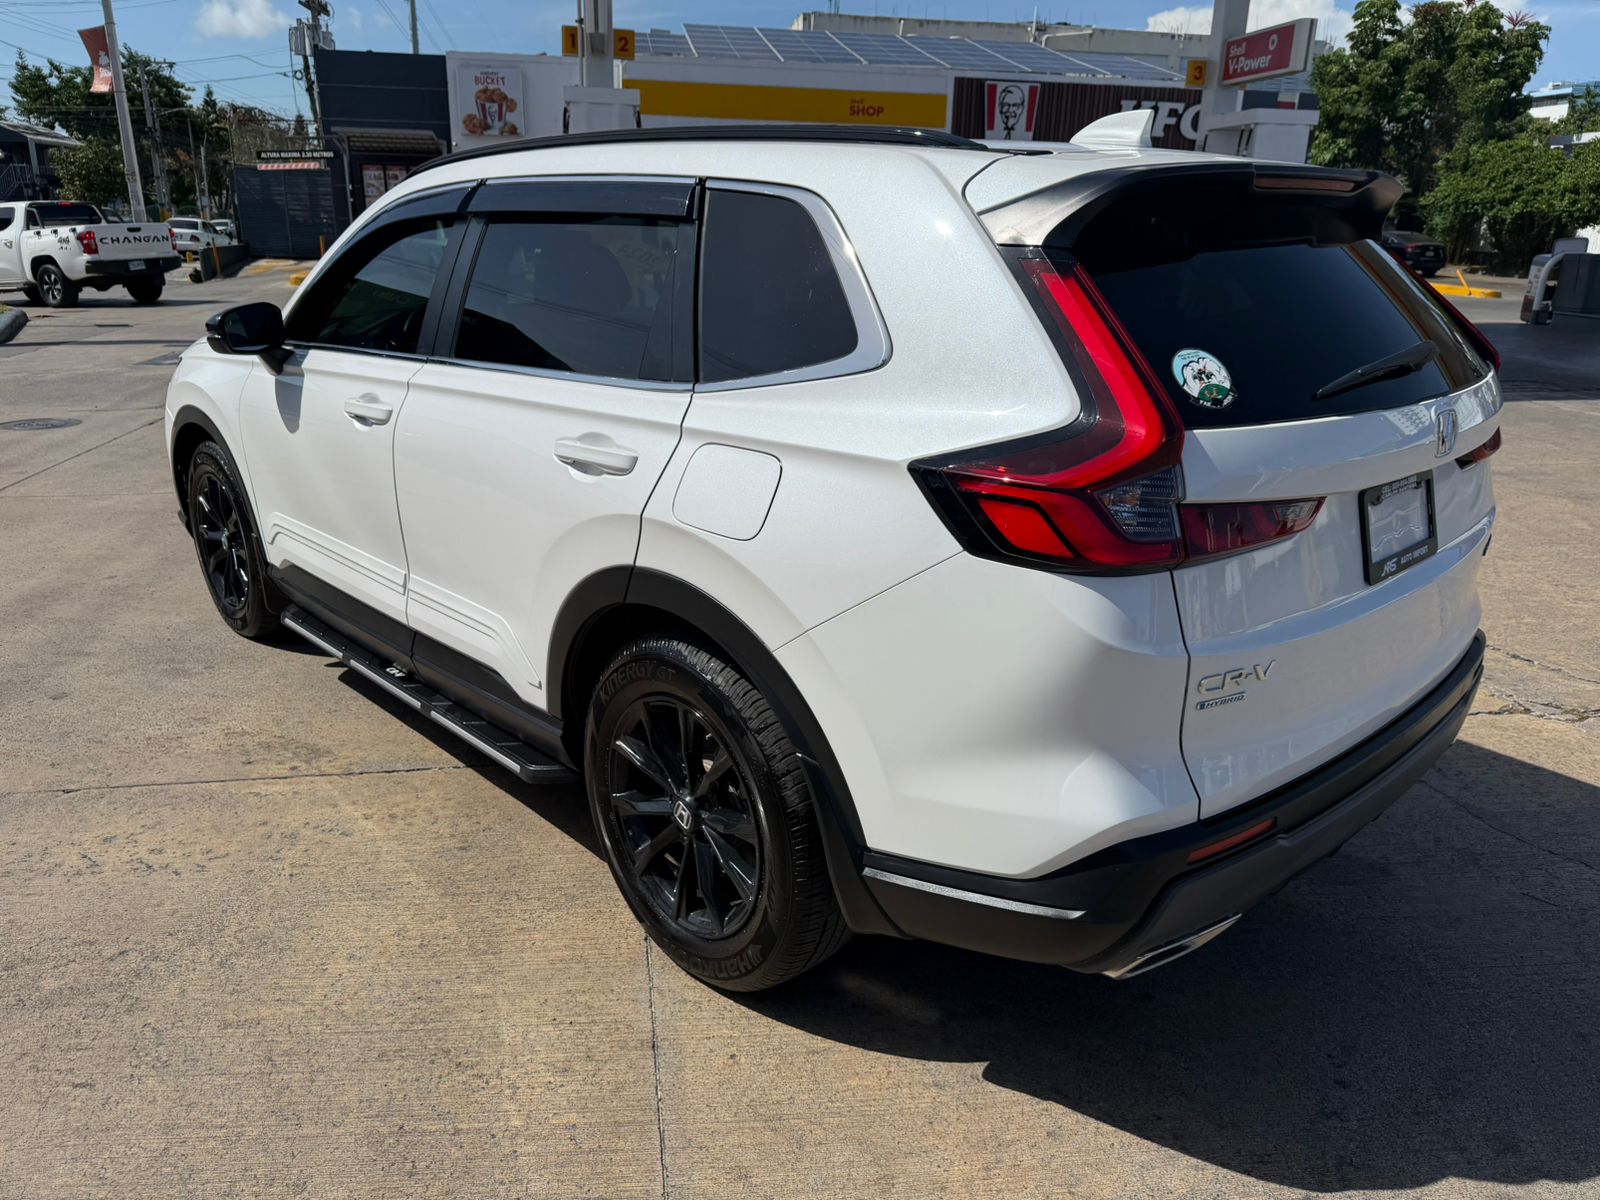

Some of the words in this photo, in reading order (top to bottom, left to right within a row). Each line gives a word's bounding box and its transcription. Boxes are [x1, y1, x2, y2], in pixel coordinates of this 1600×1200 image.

[569, 32, 576, 49] 1
[618, 36, 629, 52] 2
[1229, 41, 1246, 57] Shell
[1228, 53, 1272, 75] V-Power
[1193, 64, 1204, 81] 3
[849, 104, 884, 117] SHOP
[100, 234, 170, 245] CHANGAN
[1197, 659, 1276, 694] CR-V
